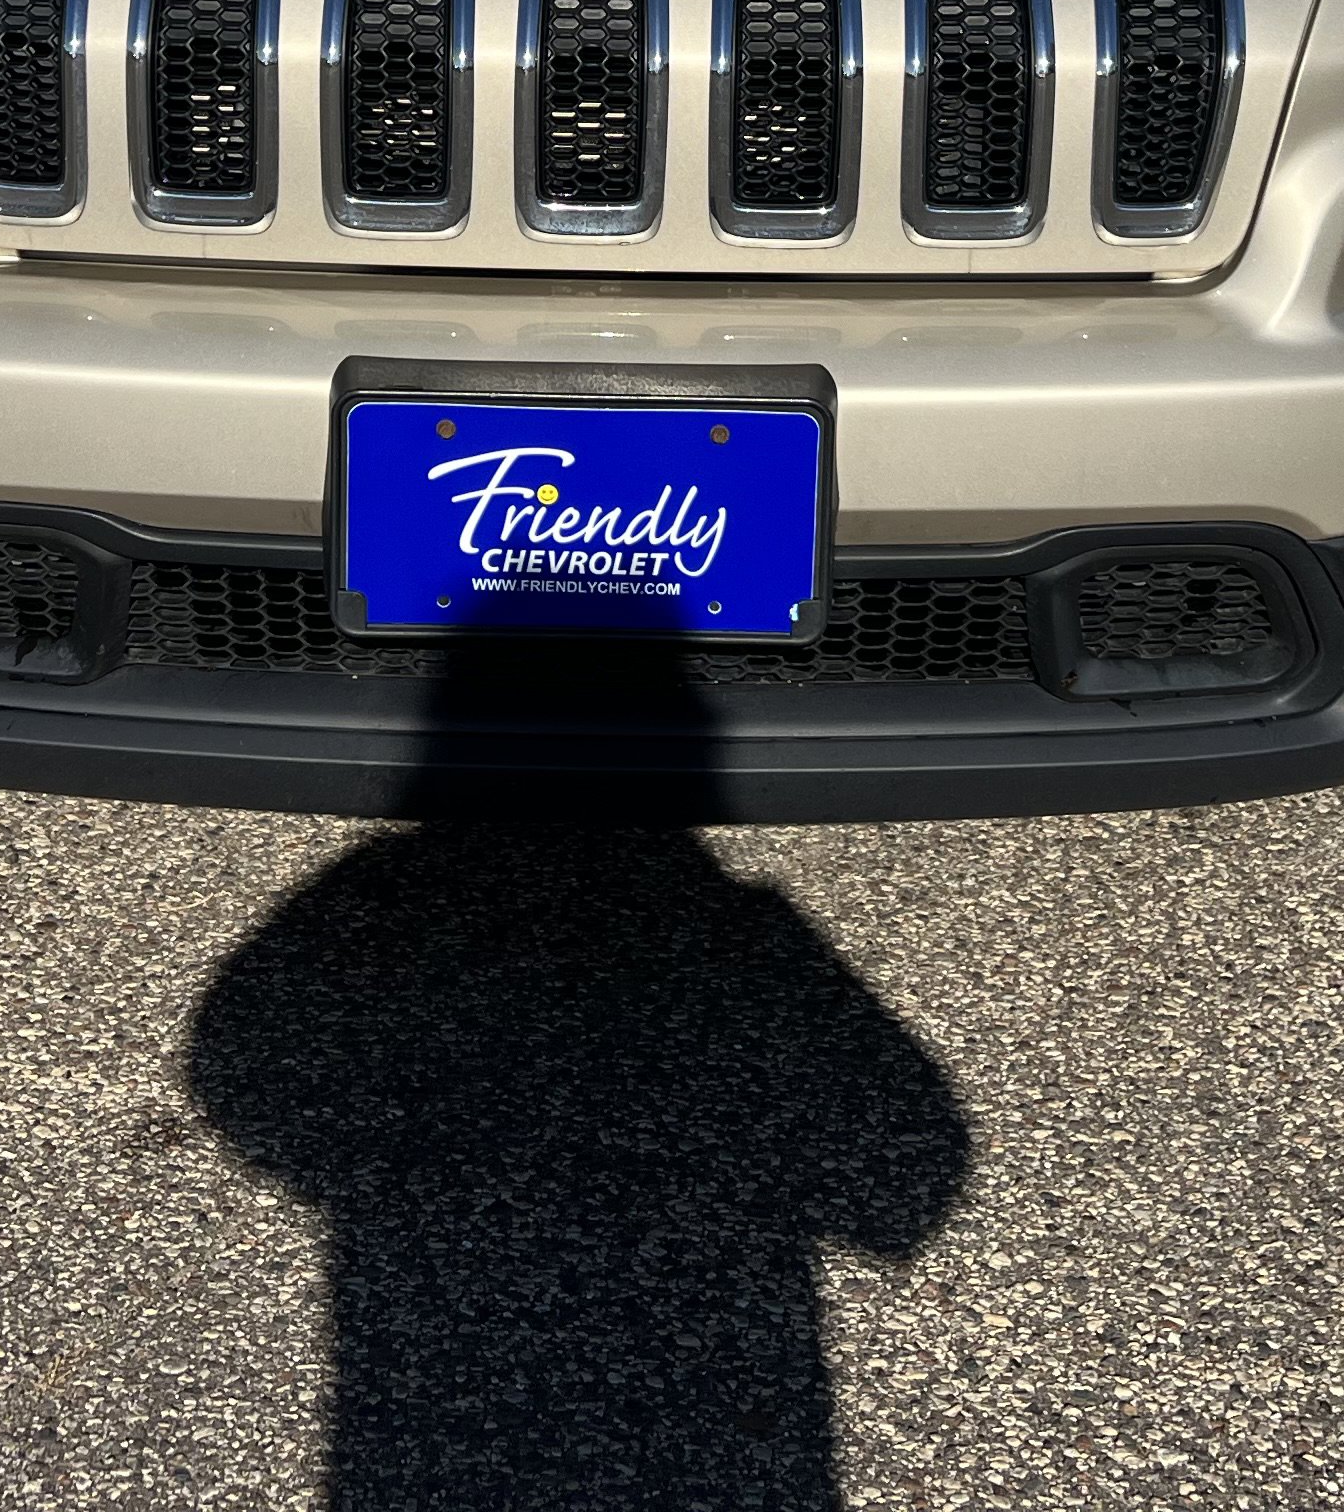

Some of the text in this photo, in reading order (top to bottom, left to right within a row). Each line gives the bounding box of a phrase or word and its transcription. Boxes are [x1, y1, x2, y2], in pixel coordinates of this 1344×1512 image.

[428, 447, 726, 577] Friendly
[481, 548, 670, 576] CHEVROLET
[472, 577, 681, 596] WWW.FRIENDLYCHEV.COM
